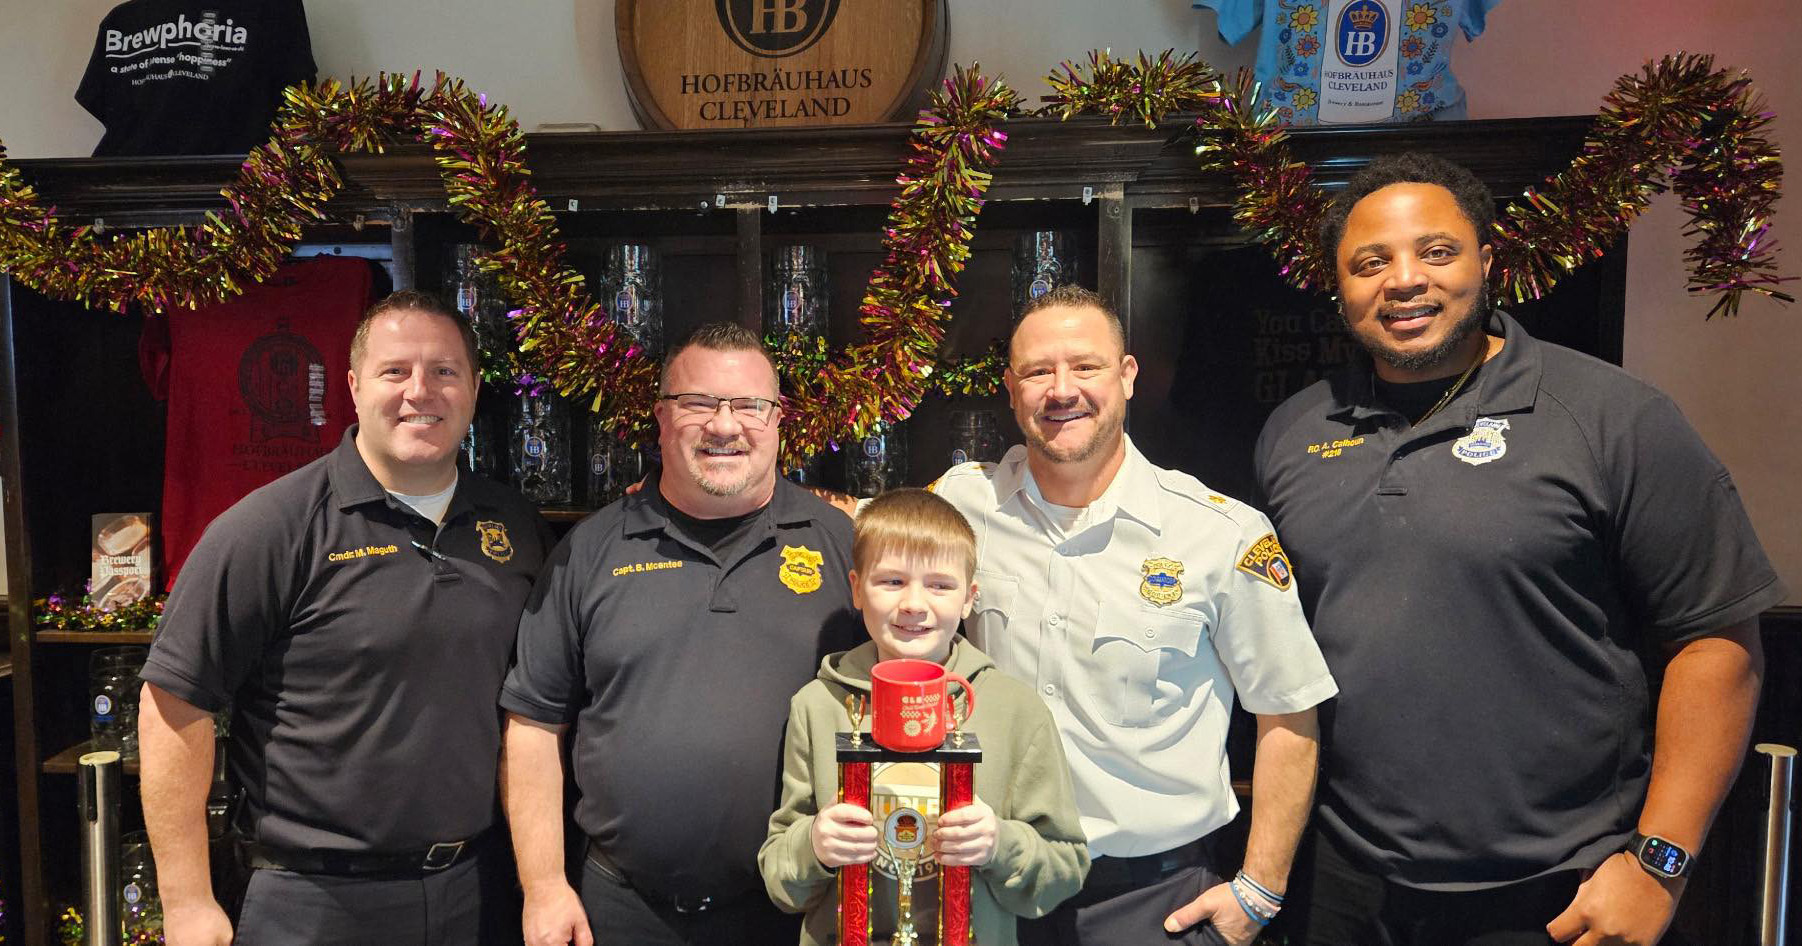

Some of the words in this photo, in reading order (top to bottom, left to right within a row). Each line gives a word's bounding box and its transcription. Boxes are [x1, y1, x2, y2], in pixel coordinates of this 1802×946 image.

[750, 0, 807, 34] HB
[105, 14, 247, 51] Brewphoria
[1344, 31, 1376, 56] HB
[139, 59, 149, 69] of
[680, 68, 873, 95] HOFBRÄUHAUS
[1328, 81, 1388, 92] CLEVELAND
[699, 97, 851, 121] CLEVELAND
[1309, 308, 1344, 334] Ca
[1332, 437, 1364, 448] Calhoun
[354, 548, 367, 558] M.
[366, 545, 398, 556] Maguth
[612, 564, 635, 576] Capt.
